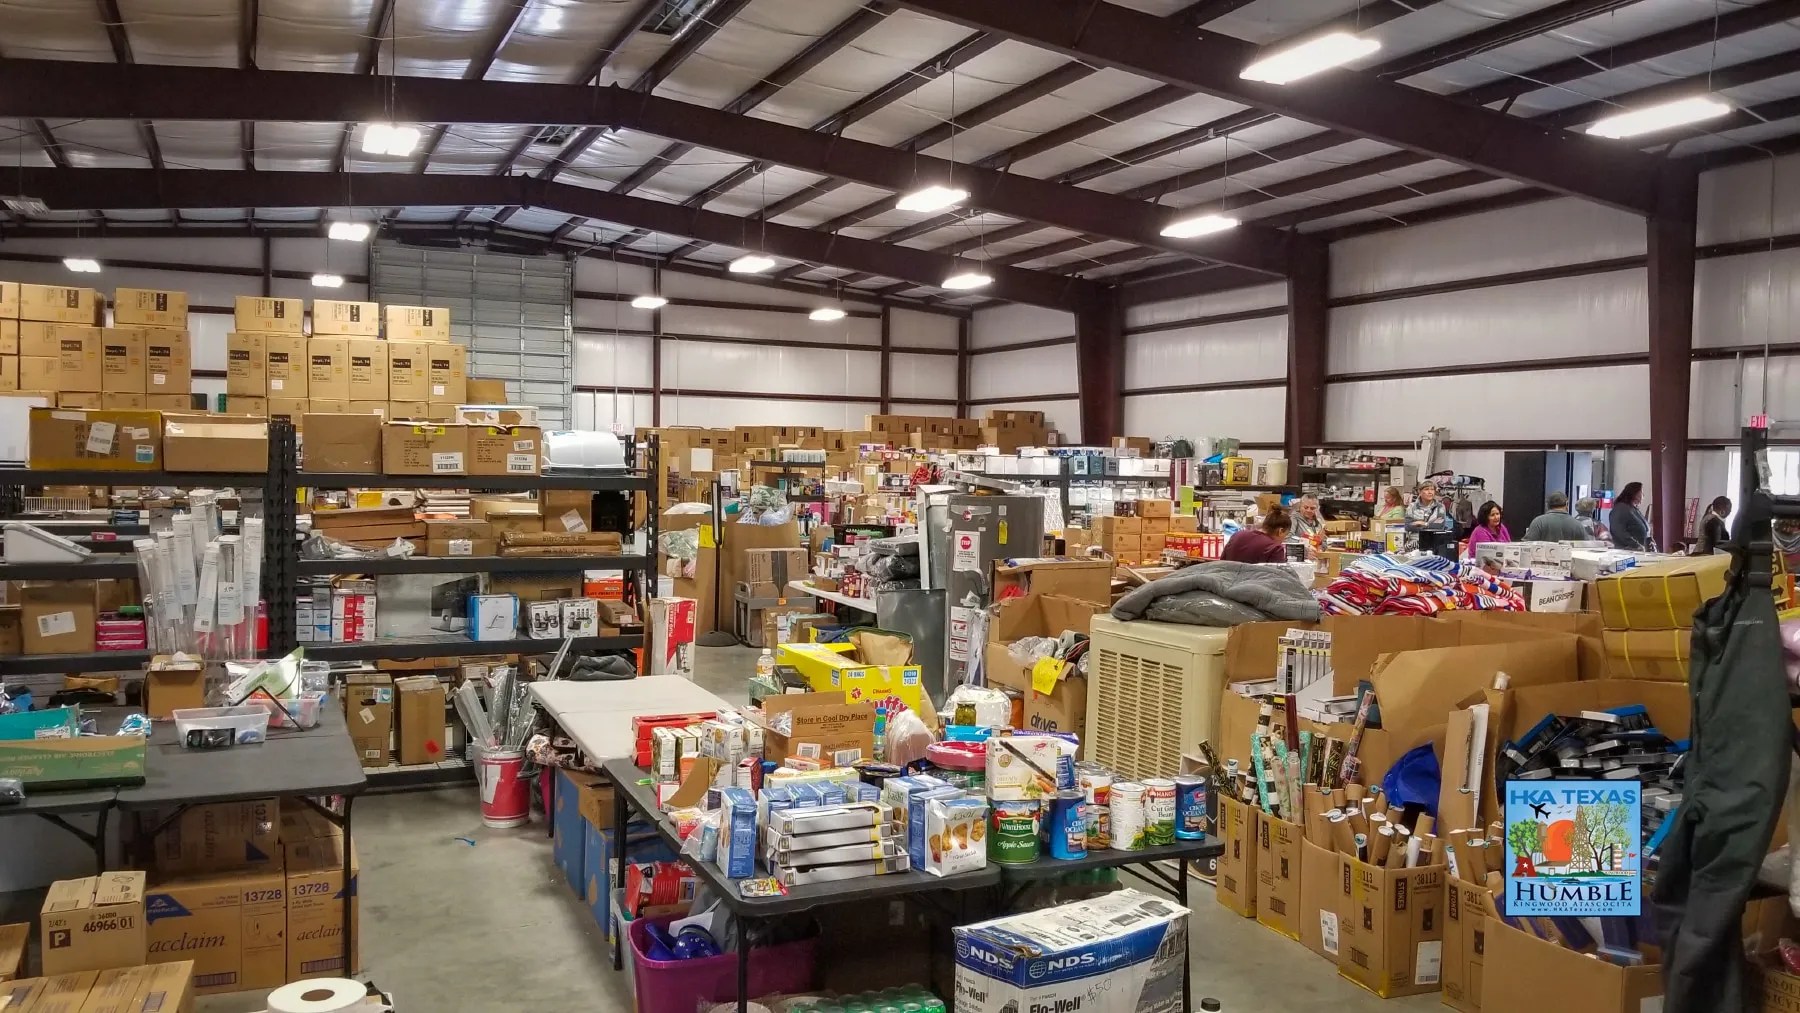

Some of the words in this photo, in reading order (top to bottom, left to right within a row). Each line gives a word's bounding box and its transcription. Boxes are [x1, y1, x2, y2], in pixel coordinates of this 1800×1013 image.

[1751, 416, 1768, 428] EXIT
[1539, 595, 1555, 606] BEAN
[1555, 590, 1576, 604] CRISPS
[796, 717, 814, 725] Store
[822, 714, 838, 723] Cool
[839, 714, 850, 722] Dry
[1031, 711, 1058, 732] drive
[997, 840, 1017, 850] Apple
[1016, 840, 1035, 849] Sauce
[1209, 859, 1217, 870] 6
[244, 889, 282, 903] 13728
[292, 882, 329, 896] 13728
[1397, 881, 1405, 909] STOKES
[83, 920, 117, 933] 46966
[119, 917, 134, 928] 01
[54, 932, 66, 946] P
[149, 932, 226, 953] acclaim
[970, 946, 1014, 970] NDS
[1048, 952, 1094, 971] NDS
[1087, 978, 1112, 1005] $50
[1030, 996, 1081, 1013] Flo-Well
